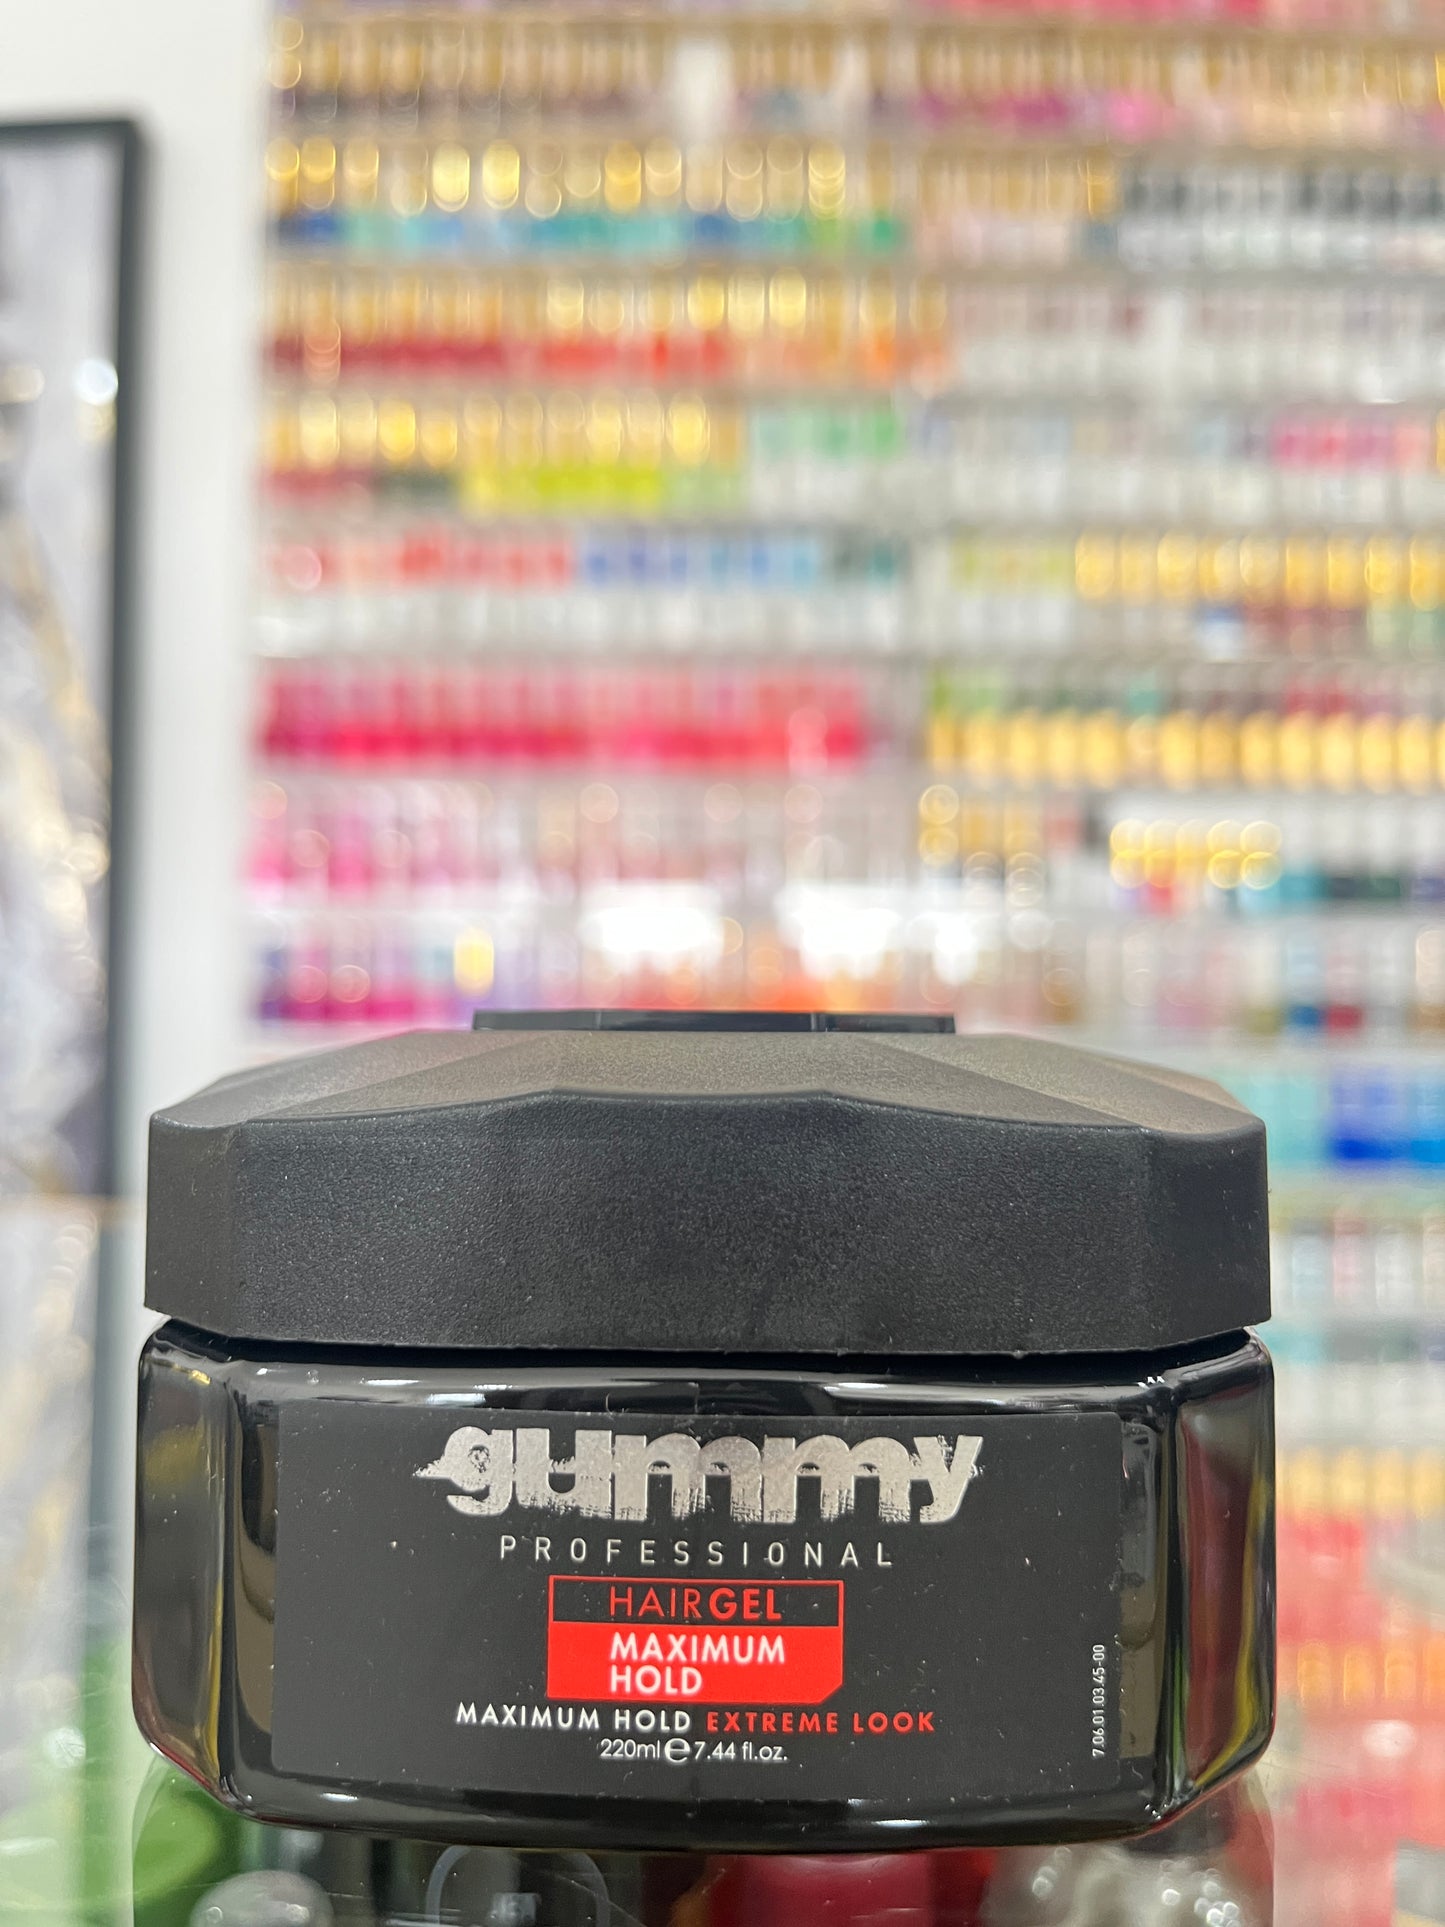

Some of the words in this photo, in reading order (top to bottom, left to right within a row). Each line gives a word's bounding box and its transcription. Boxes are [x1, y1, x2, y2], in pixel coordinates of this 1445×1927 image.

[412, 1426, 985, 1524] gummy
[500, 1535, 893, 1567] PROFESSIONAL
[610, 1632, 785, 1664] MAXIMUM
[610, 1665, 702, 1695] HOLD
[1092, 1644, 1105, 1757] 7.06.01.03.45-00
[455, 1702, 600, 1730] MAXIMUM
[614, 1708, 692, 1733] HOLD
[707, 1711, 839, 1733] EXTREME
[853, 1711, 935, 1733] LOOK
